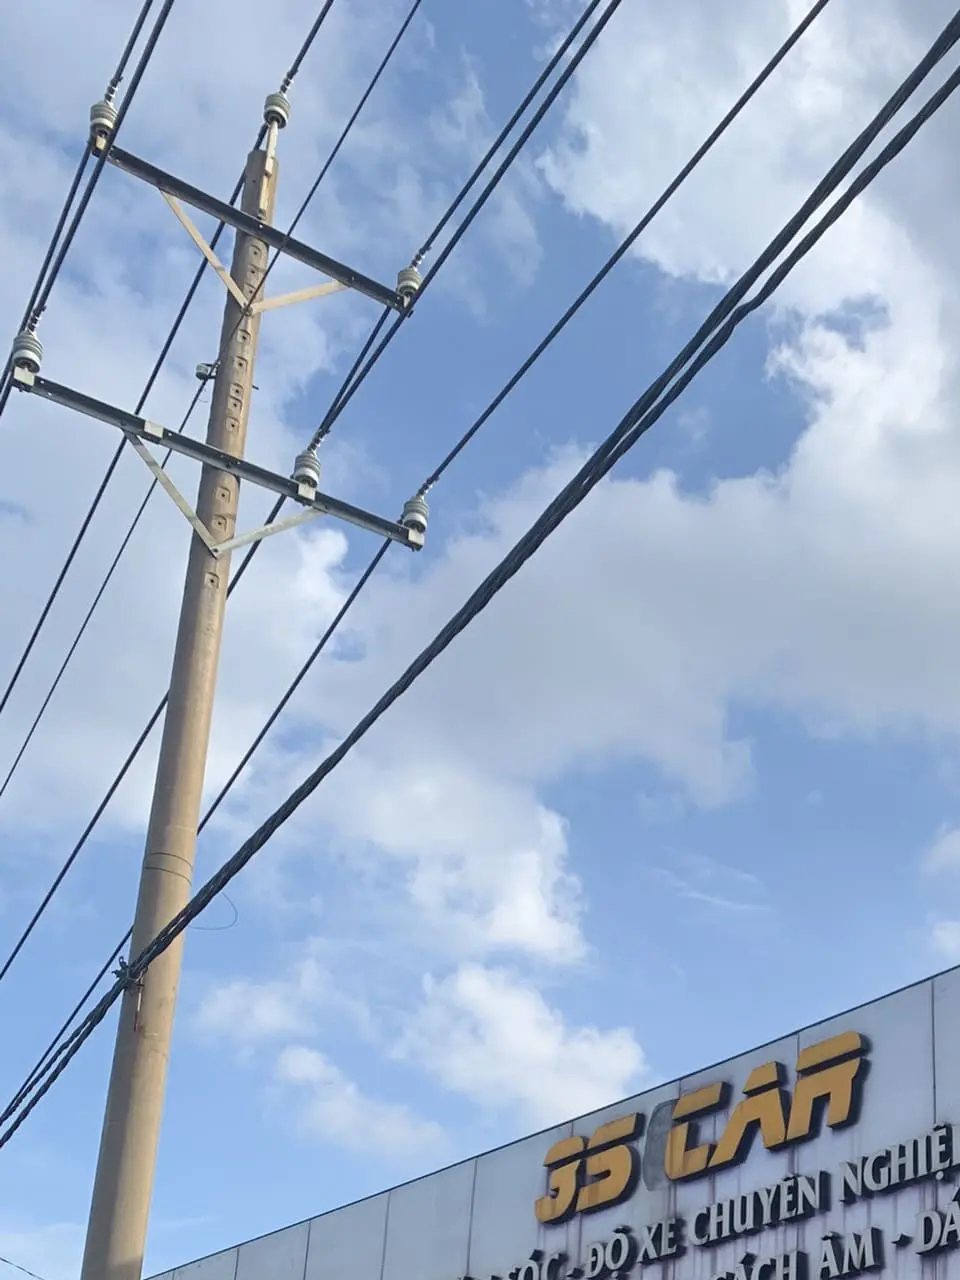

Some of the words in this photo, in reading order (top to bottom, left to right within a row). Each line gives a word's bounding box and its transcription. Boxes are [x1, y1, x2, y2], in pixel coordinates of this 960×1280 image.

[664, 1032, 864, 1180] CAR
[586, 1225, 630, 1280] ĐỘ
[637, 1218, 679, 1263] XE
[687, 1169, 820, 1246] CHUYÊN
